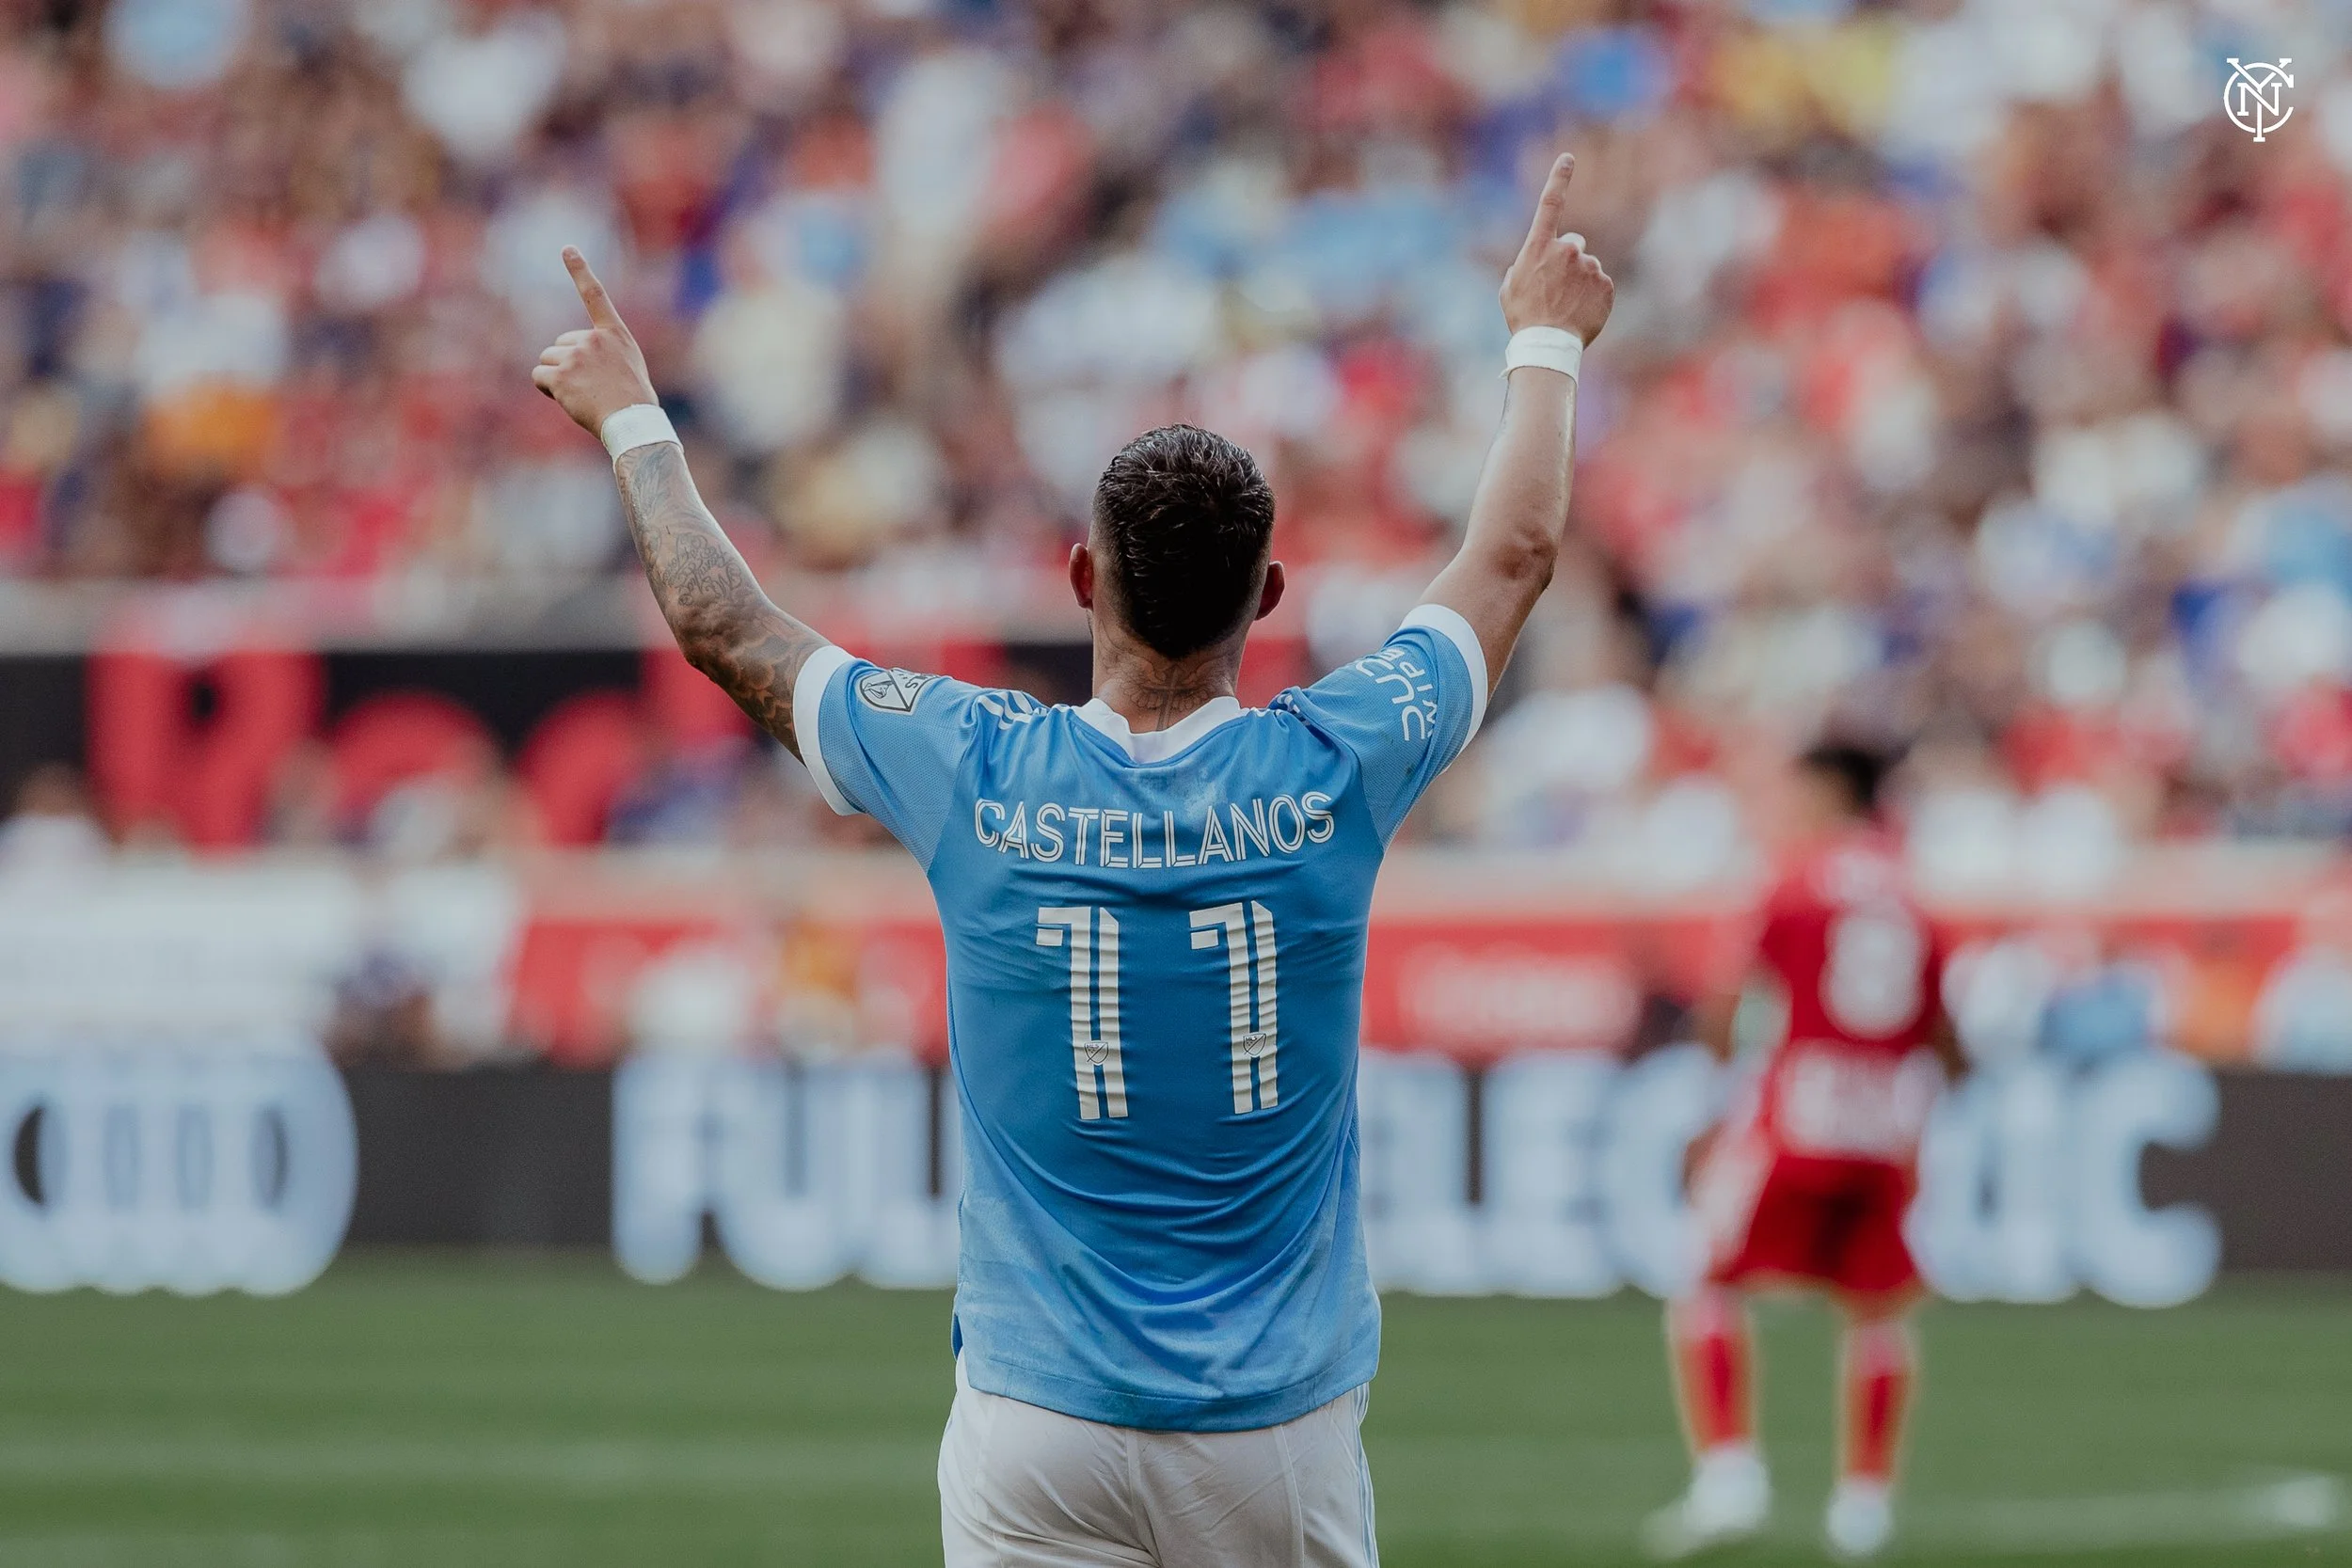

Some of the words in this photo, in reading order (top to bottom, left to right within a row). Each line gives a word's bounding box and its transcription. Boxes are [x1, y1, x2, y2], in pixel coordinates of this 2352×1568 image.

[1356, 657, 1425, 741] DUD
[1379, 646, 1438, 738] WIPE
[974, 791, 1335, 868] CASTELLANOS
[1036, 900, 1279, 1120] 11
